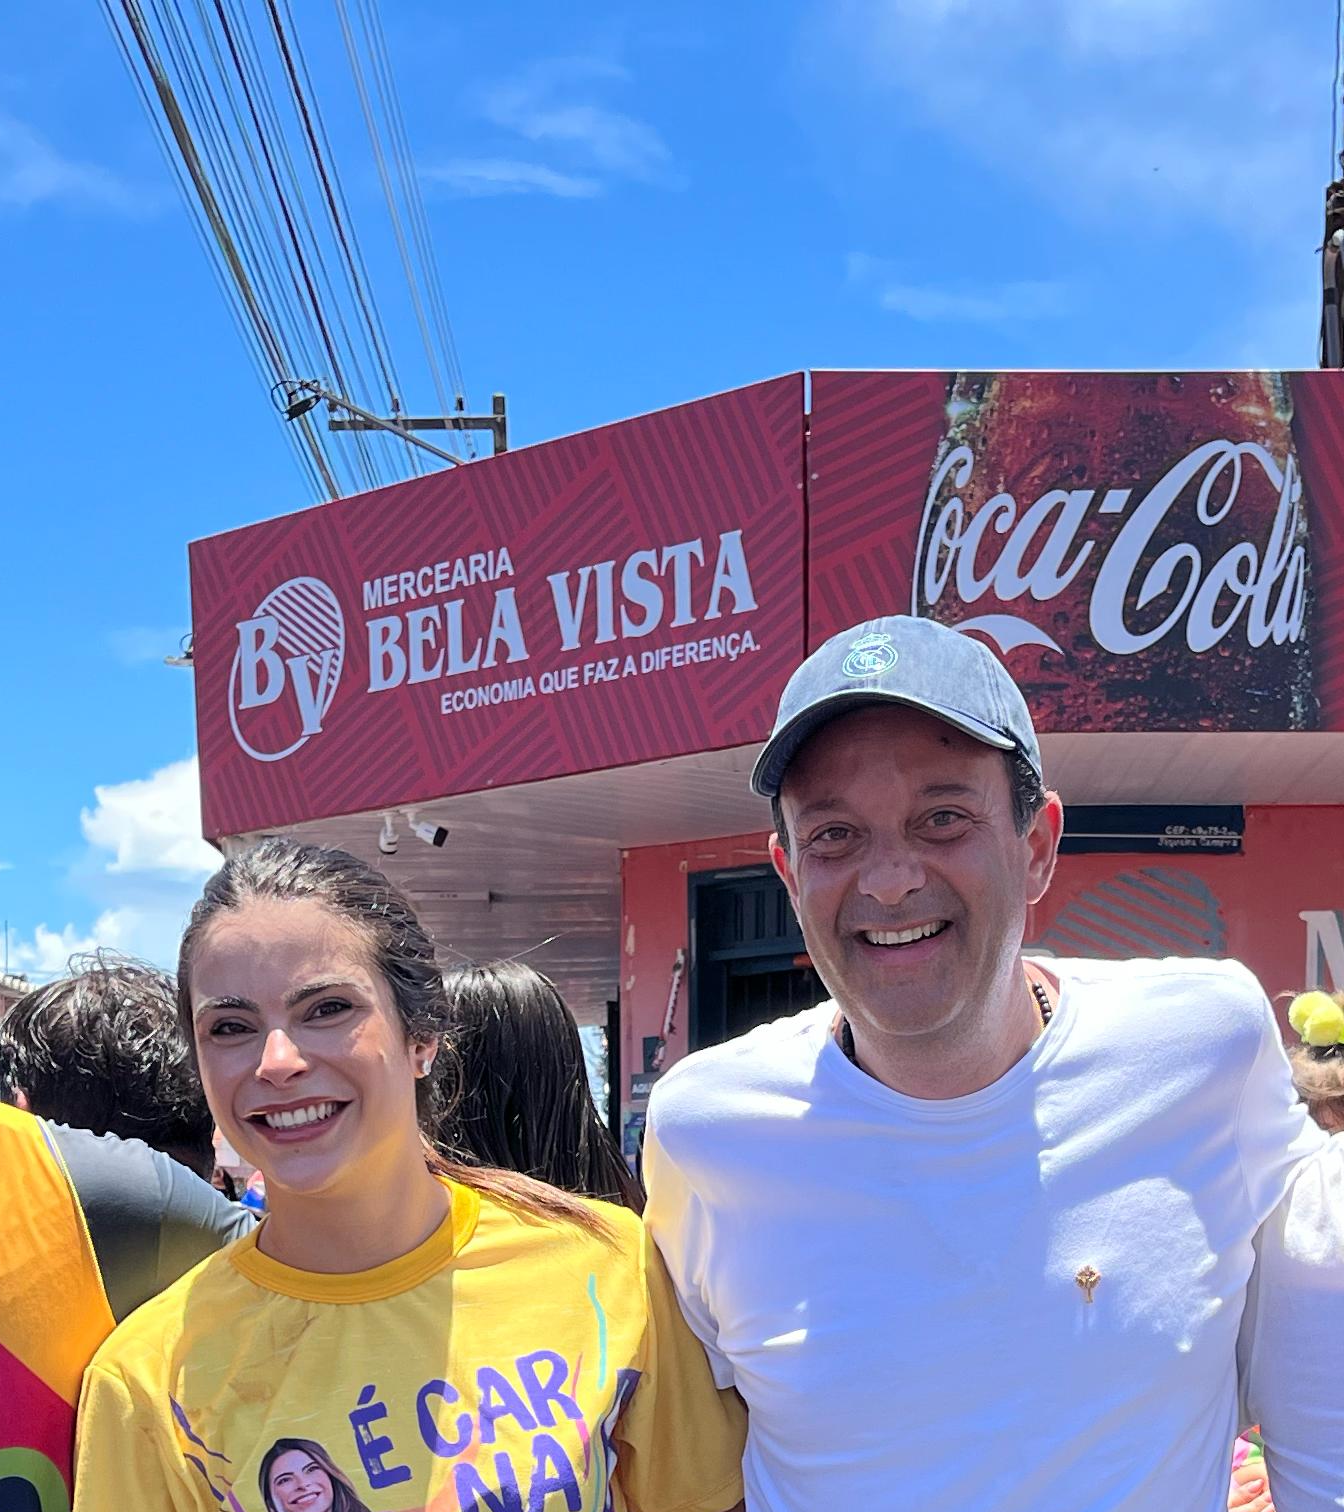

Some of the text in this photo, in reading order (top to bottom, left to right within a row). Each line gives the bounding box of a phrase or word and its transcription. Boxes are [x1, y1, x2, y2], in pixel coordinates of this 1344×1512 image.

[362, 546, 515, 611] MERCEARIA
[365, 528, 759, 694] BELA VISTA
[910, 439, 1306, 656] Coca-Cola
[440, 630, 762, 716] ECONOMIA QUE FAZ A DIFERENÇA.
[348, 1349, 585, 1491] É CAR
